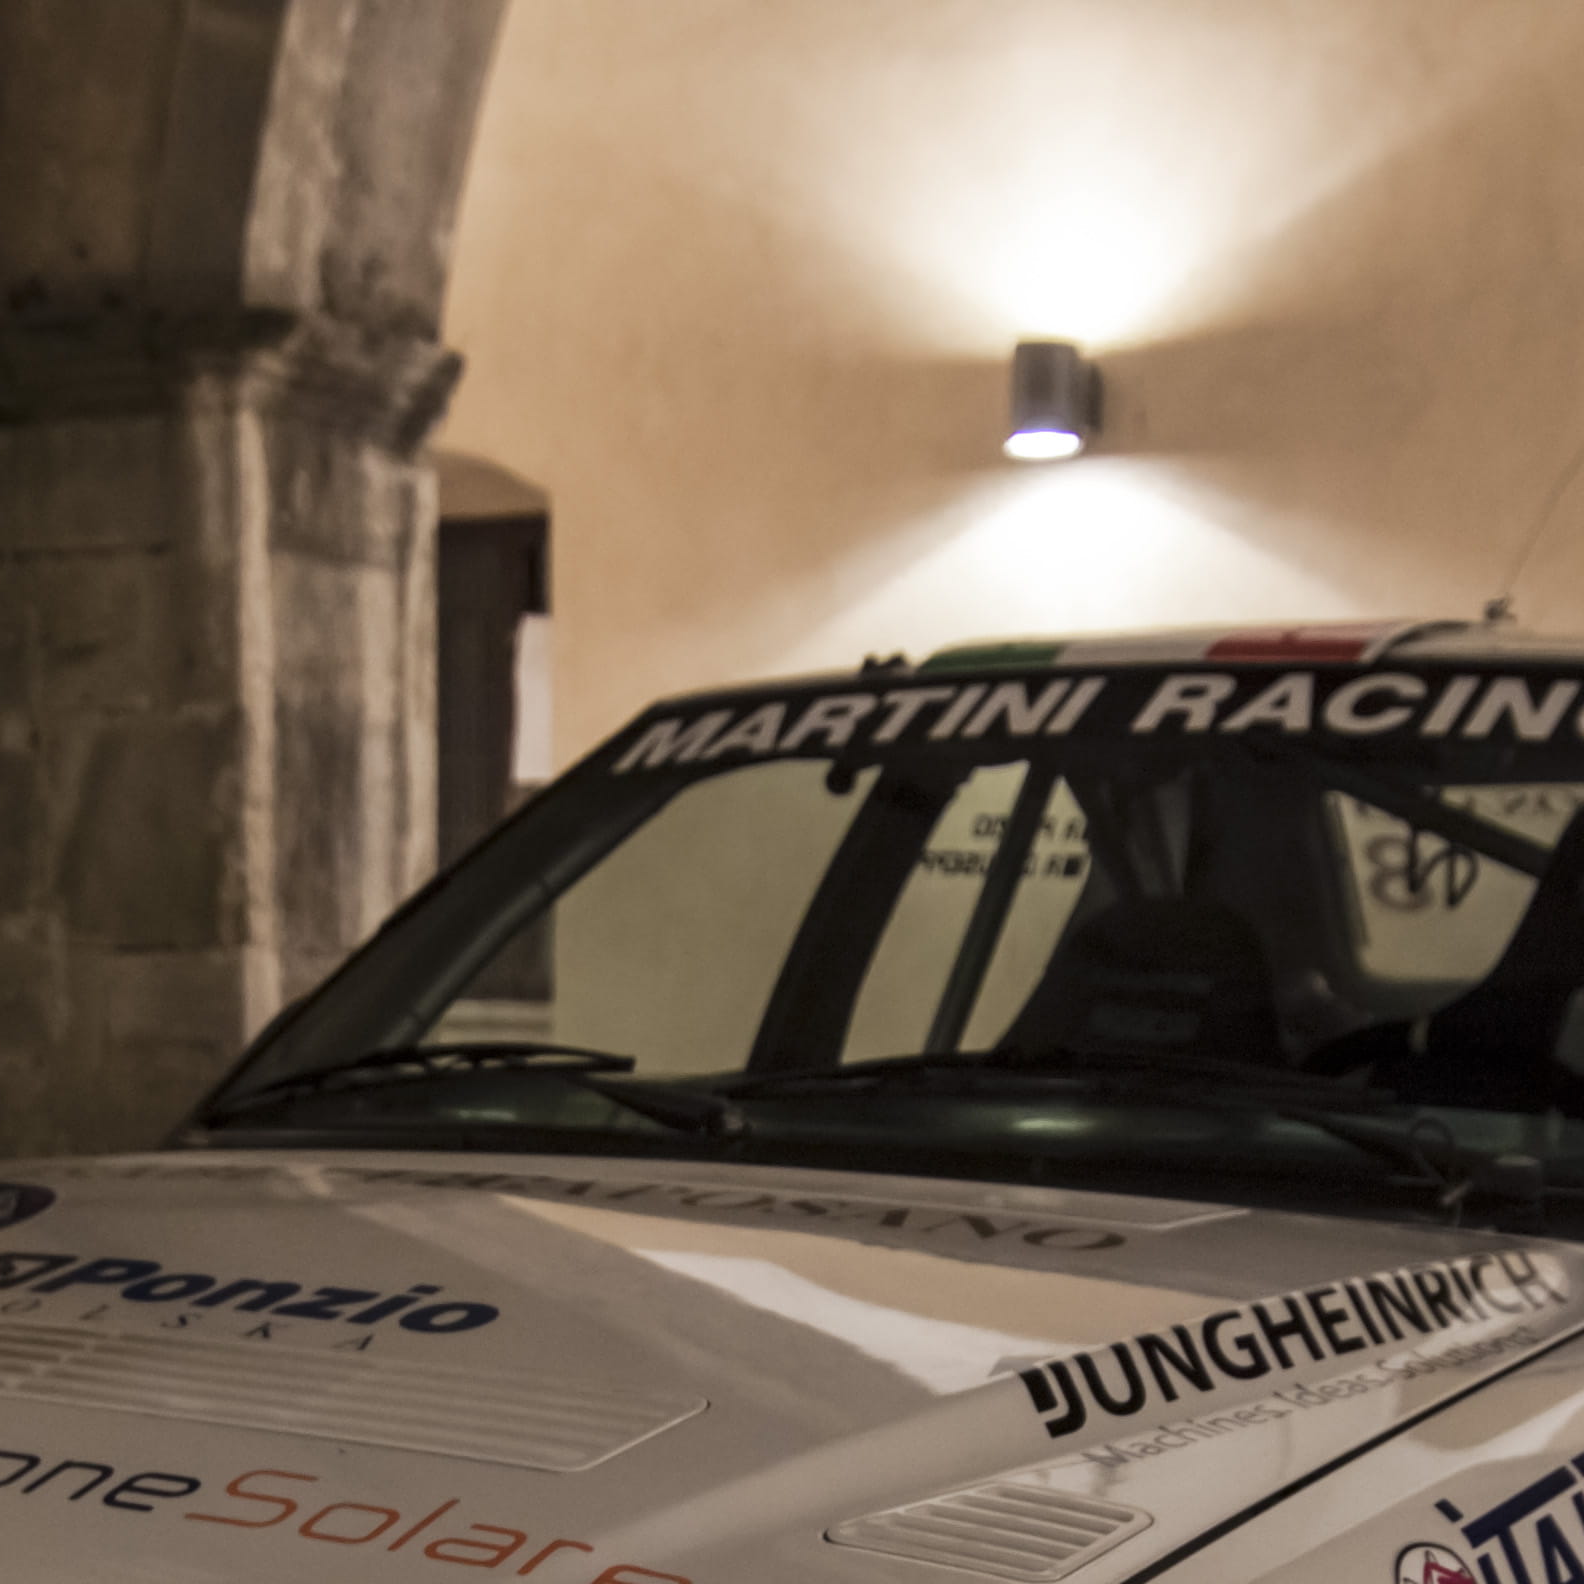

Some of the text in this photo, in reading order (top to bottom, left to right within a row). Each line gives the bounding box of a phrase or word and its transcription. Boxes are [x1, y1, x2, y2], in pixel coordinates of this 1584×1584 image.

[612, 676, 1108, 775] MARTINI
[28, 1256, 501, 1335] Ponzio
[1021, 1250, 1566, 1439] JUNGHEINRICH
